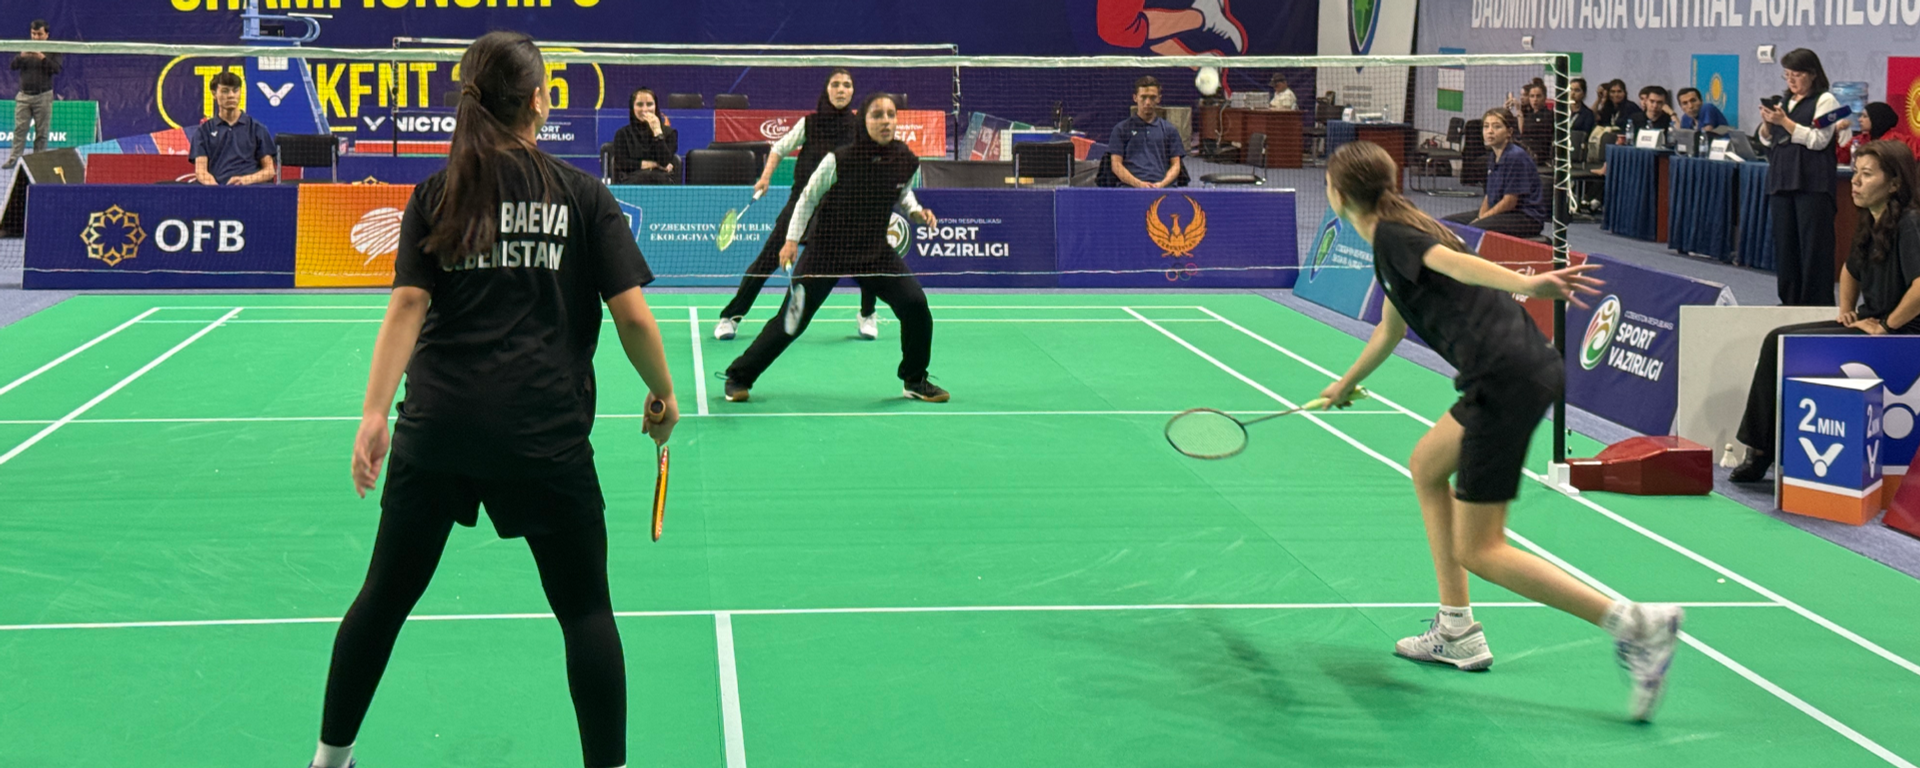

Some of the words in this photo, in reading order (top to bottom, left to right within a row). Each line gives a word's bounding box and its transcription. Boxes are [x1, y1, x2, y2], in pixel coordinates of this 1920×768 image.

[194, 62, 437, 119] TAKENT
[390, 116, 457, 132] VICTO
[536, 133, 575, 141] AZIRLIGI
[894, 130, 917, 142] SIA
[500, 202, 569, 237] BAEVA
[916, 226, 979, 240] SPORT
[155, 219, 245, 252] OFB
[916, 243, 1009, 257] VAZIRLIGI
[443, 240, 564, 272] BEKISTAN
[1616, 322, 1656, 350] SPORT
[1608, 346, 1664, 381] VAZIRLIGI
[1799, 398, 1816, 433] 2
[1817, 417, 1845, 438] MIN
